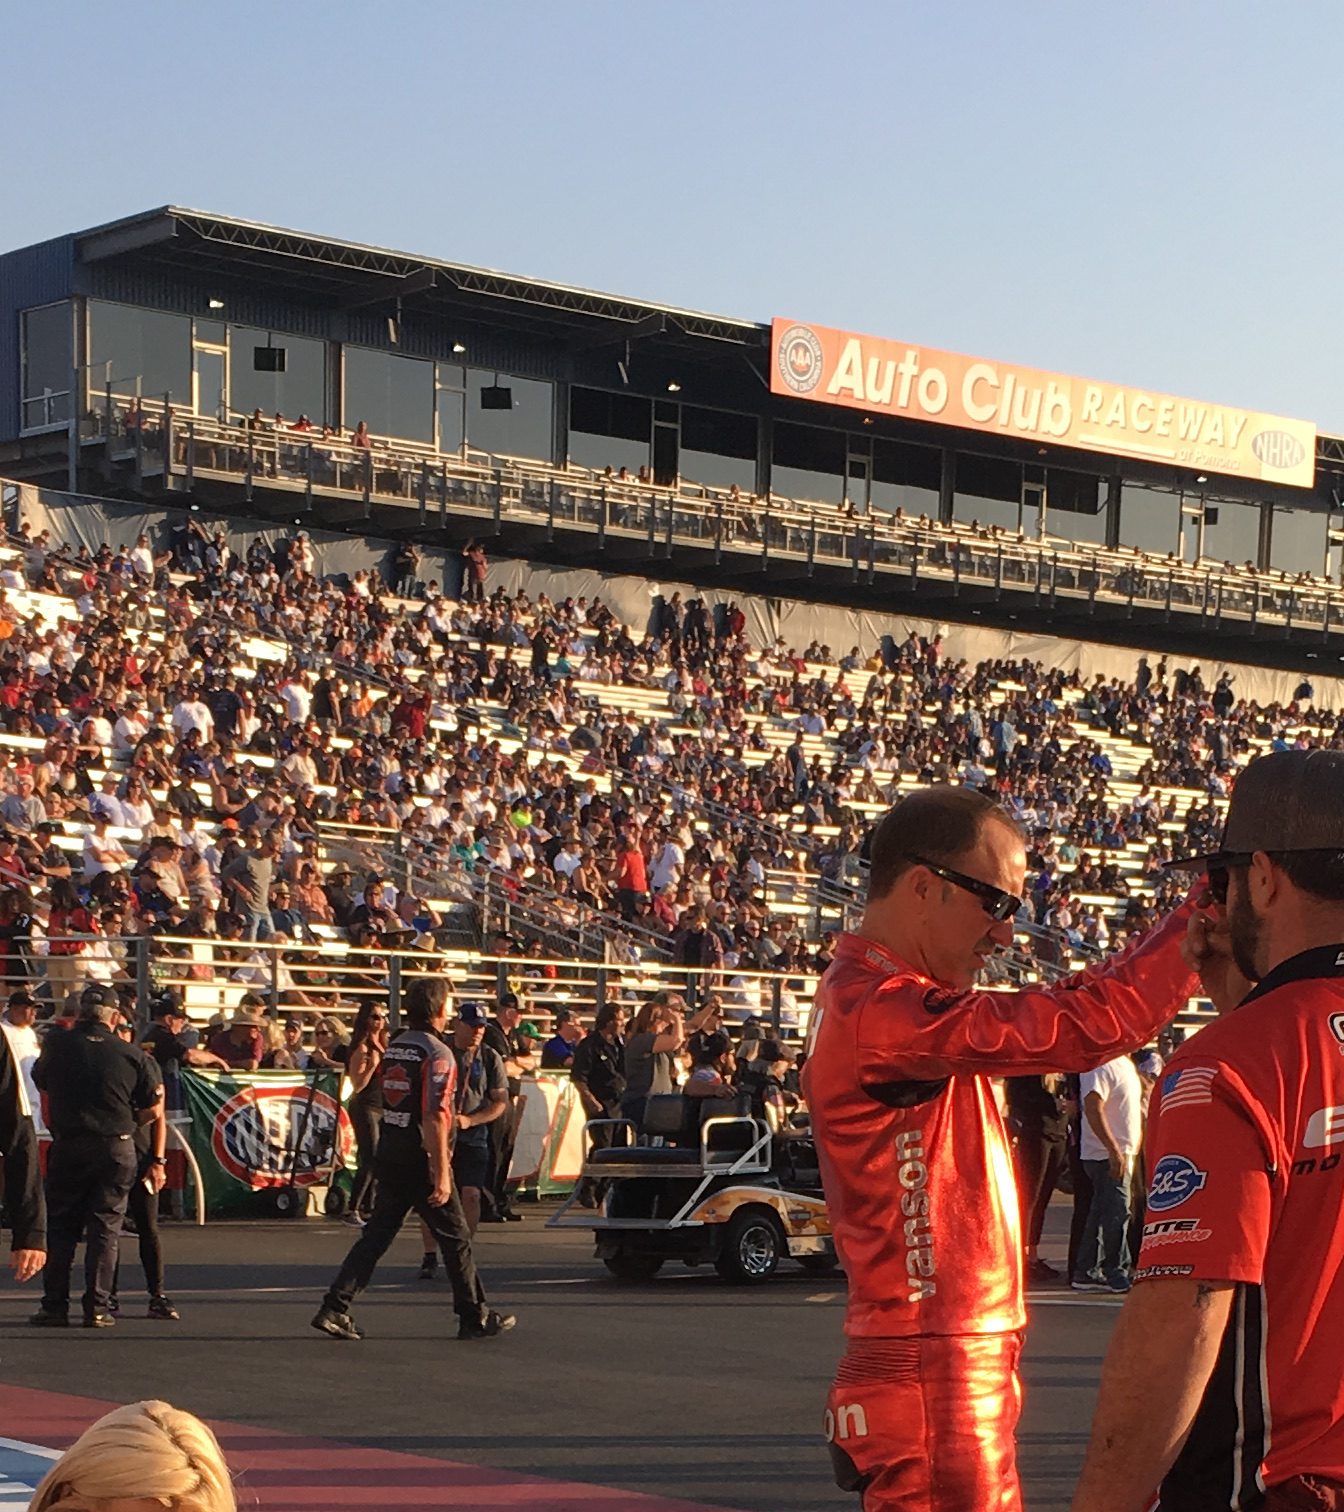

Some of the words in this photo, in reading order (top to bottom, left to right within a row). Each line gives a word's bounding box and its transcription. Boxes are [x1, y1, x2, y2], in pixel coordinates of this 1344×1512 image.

[826, 338, 949, 415] Auto
[961, 363, 1074, 439] Club
[1081, 386, 1248, 449] RACEWAY
[1194, 447, 1240, 471] Pomona
[1256, 432, 1302, 468] NHRA
[895, 1129, 937, 1303] vanson
